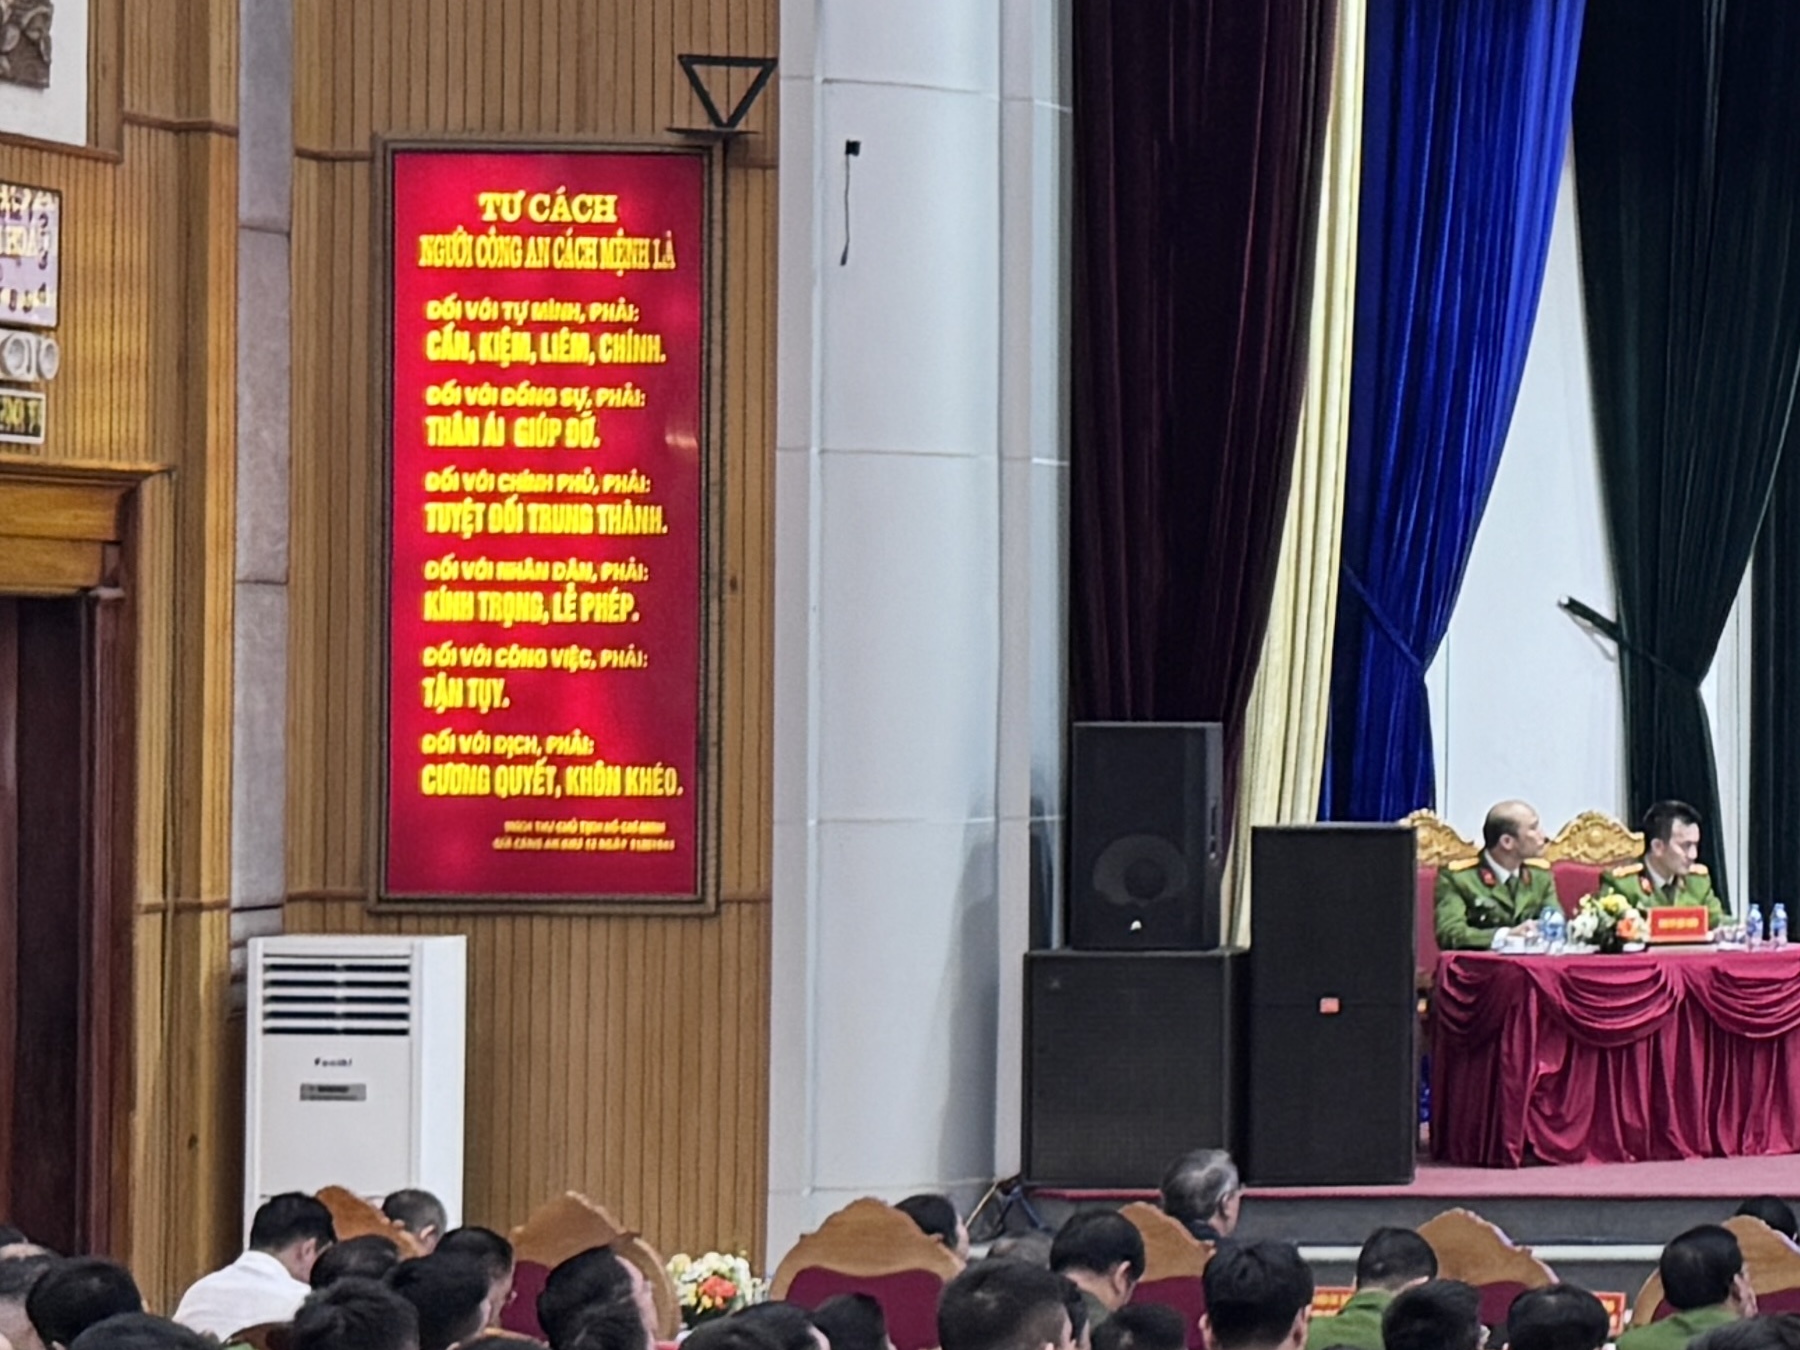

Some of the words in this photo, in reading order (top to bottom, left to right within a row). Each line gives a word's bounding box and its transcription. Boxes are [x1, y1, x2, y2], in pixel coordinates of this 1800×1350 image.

[478, 189, 526, 222] TƯ
[528, 185, 618, 223] CÁCH
[418, 224, 473, 268] NGƯỜI
[476, 225, 522, 268] CÔNG
[525, 235, 551, 268] AN
[553, 227, 598, 269] CÁCH
[599, 228, 650, 277] MỆNH
[653, 230, 675, 270] LÀ
[426, 293, 462, 320] ĐỐI
[464, 296, 498, 320] VỚI
[501, 300, 529, 325] TỰ
[588, 296, 639, 322] PHẢI:
[479, 325, 537, 368] KIỆM,
[540, 326, 596, 366] LIÊM,
[599, 328, 666, 363] CHÍNH.
[425, 379, 462, 406] ĐỐI
[464, 382, 498, 406] VỚI
[560, 387, 593, 410] SỰ,
[596, 382, 646, 407] PHẢI:
[425, 410, 479, 446] THÂN
[482, 410, 505, 446] ÁI
[514, 411, 562, 447] GIÚP
[565, 410, 600, 448] ĐỠ.
[425, 465, 460, 492] ĐỐI
[462, 468, 495, 492] VỚI
[556, 467, 599, 495] PHỦ,
[602, 468, 650, 493] PHẢI:
[424, 497, 486, 540] TUYỆT
[488, 493, 524, 533] ĐỐI
[527, 503, 594, 534] TRUNG
[597, 498, 668, 534] THÀNH.
[424, 552, 459, 581] ĐỐI
[462, 556, 494, 581] VỚI
[496, 557, 549, 581] NHÂN
[552, 557, 598, 583] DÂN,
[601, 556, 649, 581] PHẢI:
[423, 585, 474, 621] KÍNH
[478, 591, 549, 628] TRỌNG,
[552, 581, 577, 622] LỄ
[580, 586, 640, 622] PHÉP.
[423, 640, 458, 666] ĐỐI
[460, 643, 492, 667] VỚI
[495, 643, 547, 668] CÔNG
[551, 645, 597, 673] VIỆC,
[600, 644, 648, 669] PHẢI:
[422, 671, 463, 715] TẬN
[421, 728, 456, 754] ĐỐI
[458, 730, 491, 754] VỚI
[494, 734, 543, 759] ĐỊCH,
[546, 728, 594, 756] PHẢI:
[421, 762, 491, 796] CƯƠNG
[494, 756, 562, 798] QUYẾT,
[565, 759, 621, 796] KHÔN
[625, 762, 684, 797] KHÉO.
